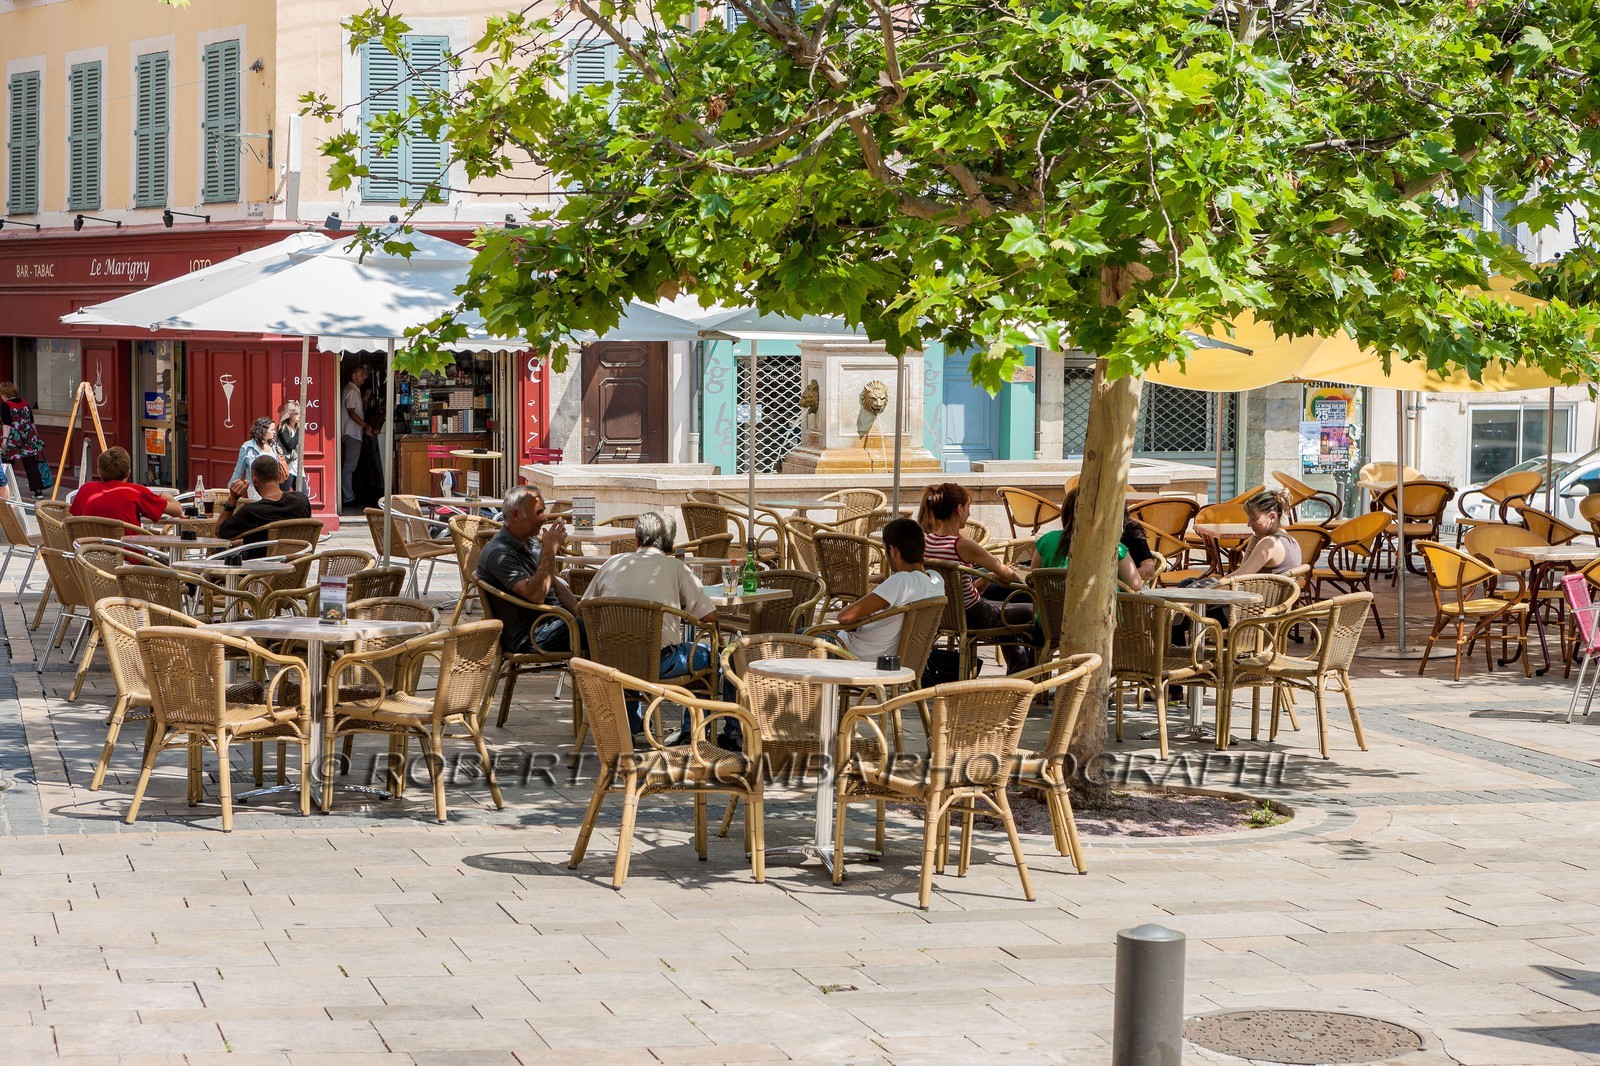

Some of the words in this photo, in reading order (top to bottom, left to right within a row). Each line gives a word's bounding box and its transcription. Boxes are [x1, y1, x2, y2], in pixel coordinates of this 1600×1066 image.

[16, 264, 30, 277] BAR
[33, 263, 55, 277] TABAC
[89, 258, 102, 276] Le
[104, 257, 151, 282] Marigny
[294, 376, 314, 385] BR
[531, 414, 538, 424] 1
[1315, 410, 1329, 422] 25
[527, 431, 539, 443] 7
